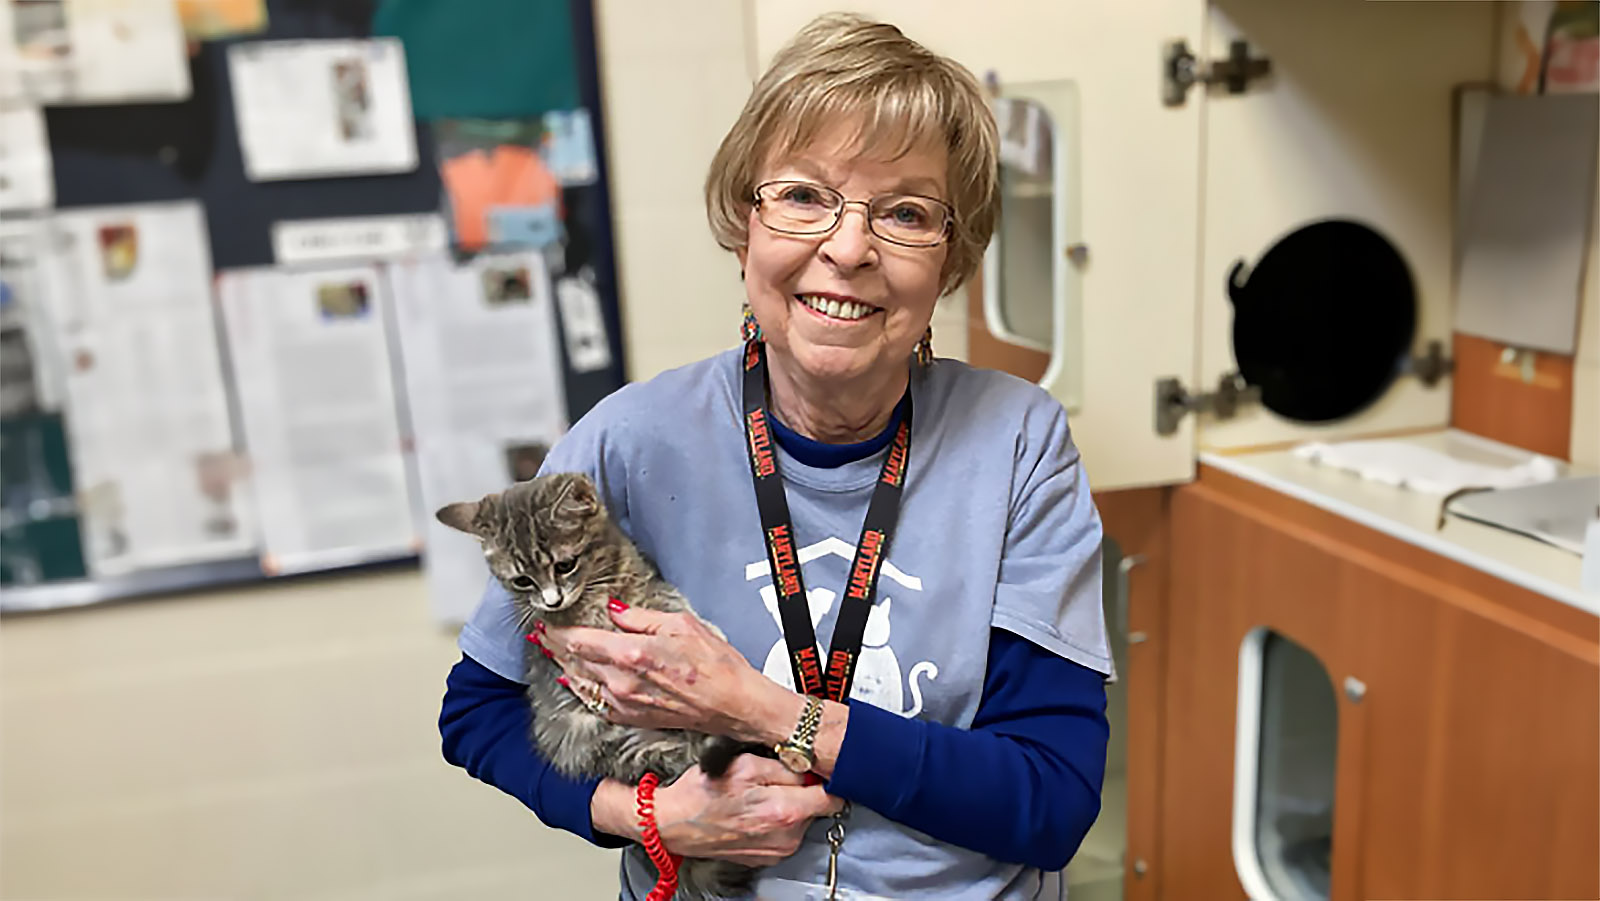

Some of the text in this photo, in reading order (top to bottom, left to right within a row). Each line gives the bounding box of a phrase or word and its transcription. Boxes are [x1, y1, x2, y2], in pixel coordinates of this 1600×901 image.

[748, 408, 776, 477] MARYLAND
[773, 525, 800, 597] MARYLAND
[849, 529, 880, 599] MARYLAND
